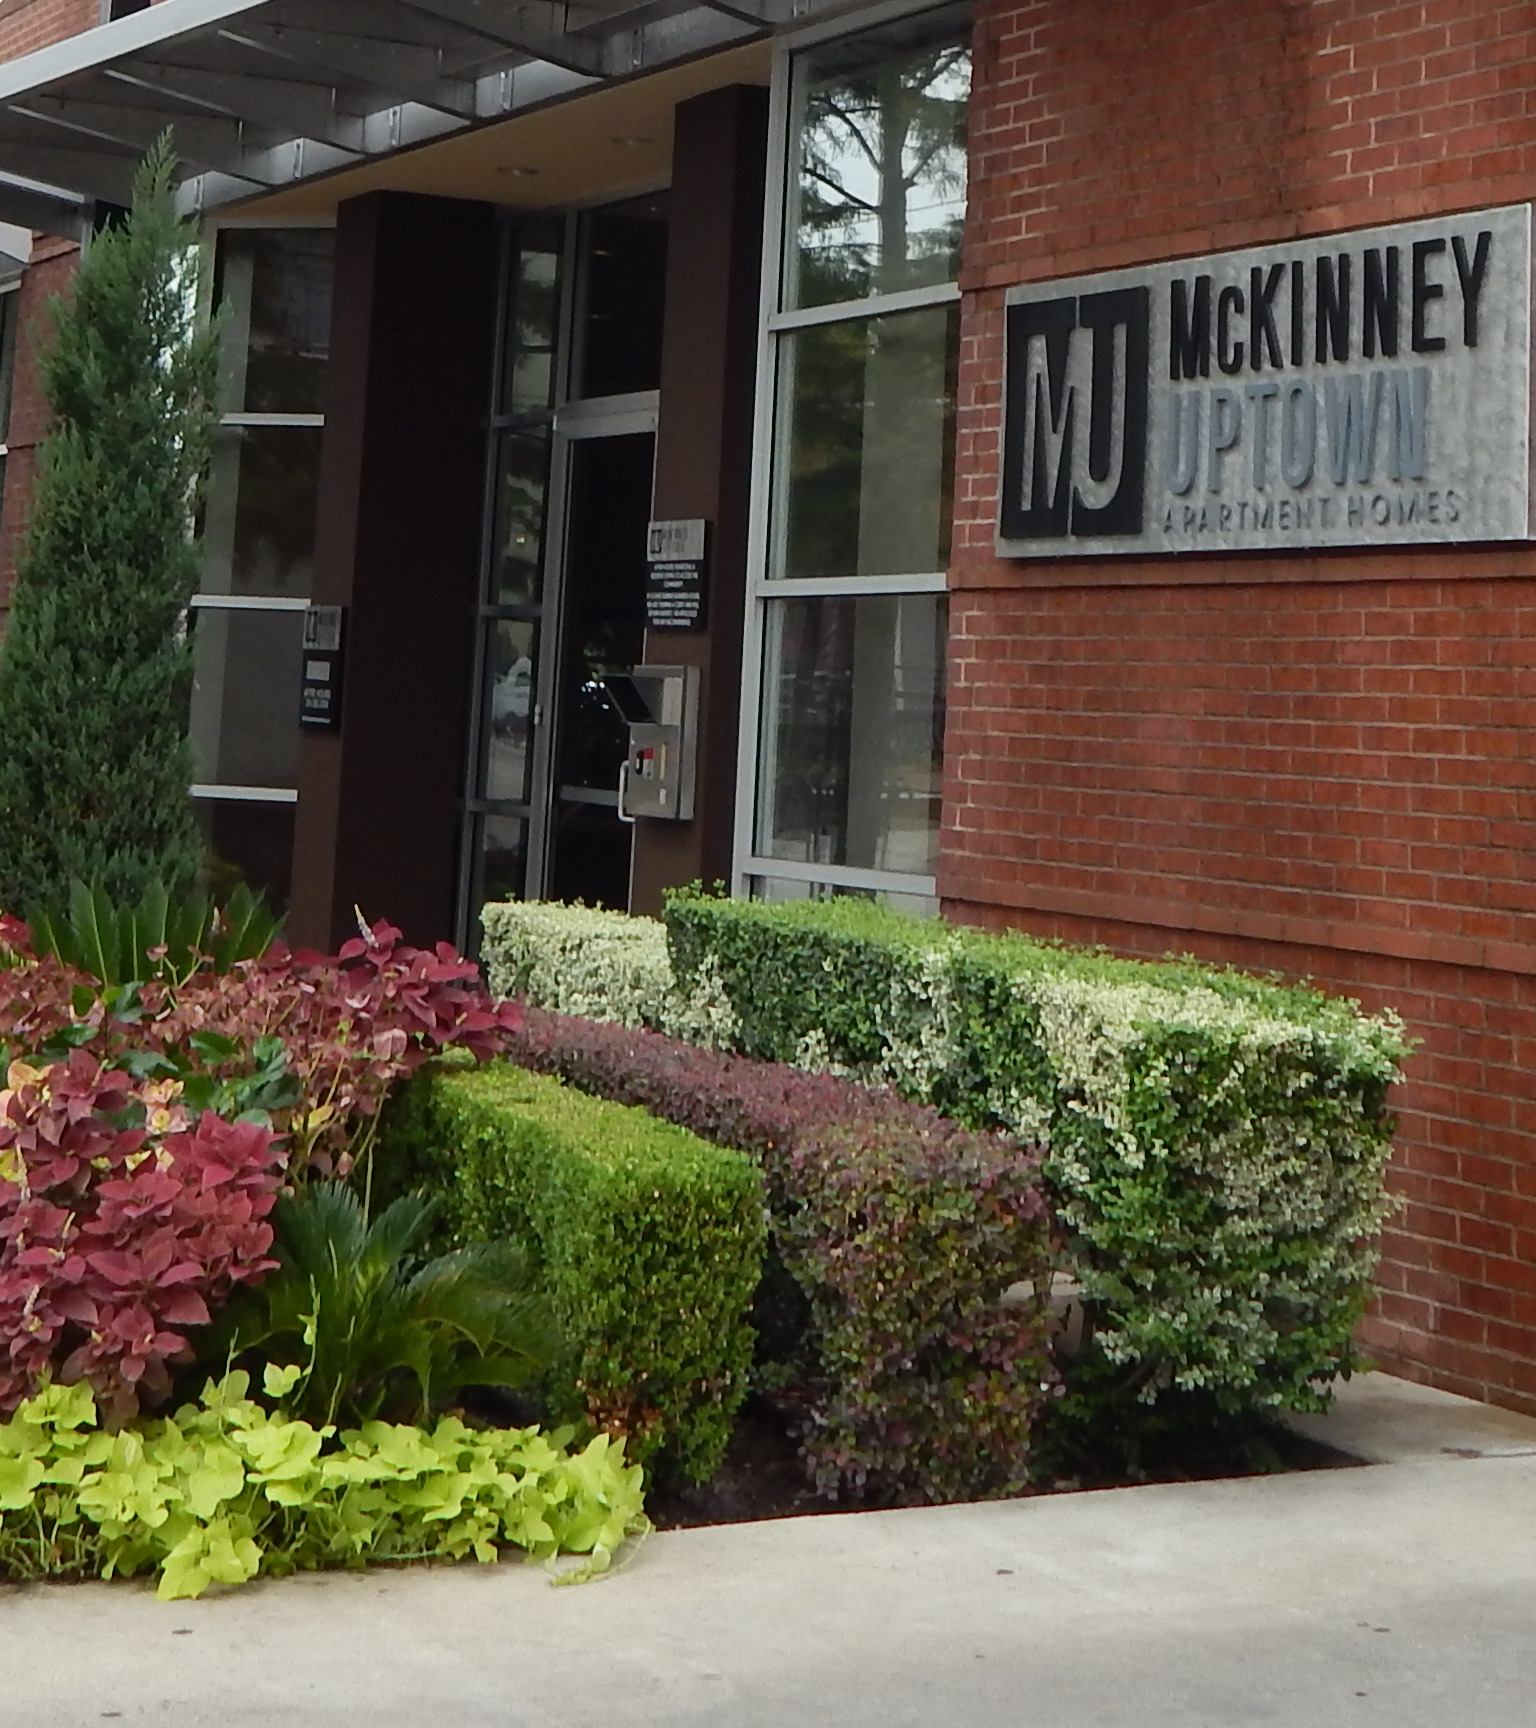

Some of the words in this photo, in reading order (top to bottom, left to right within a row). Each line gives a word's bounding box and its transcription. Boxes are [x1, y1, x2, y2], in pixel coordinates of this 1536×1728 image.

[1169, 230, 1493, 381] McKINNEY
[1166, 365, 1431, 497] UPTOWN
[1163, 497, 1331, 534] APARTMENT
[1346, 488, 1461, 528] HOMES
